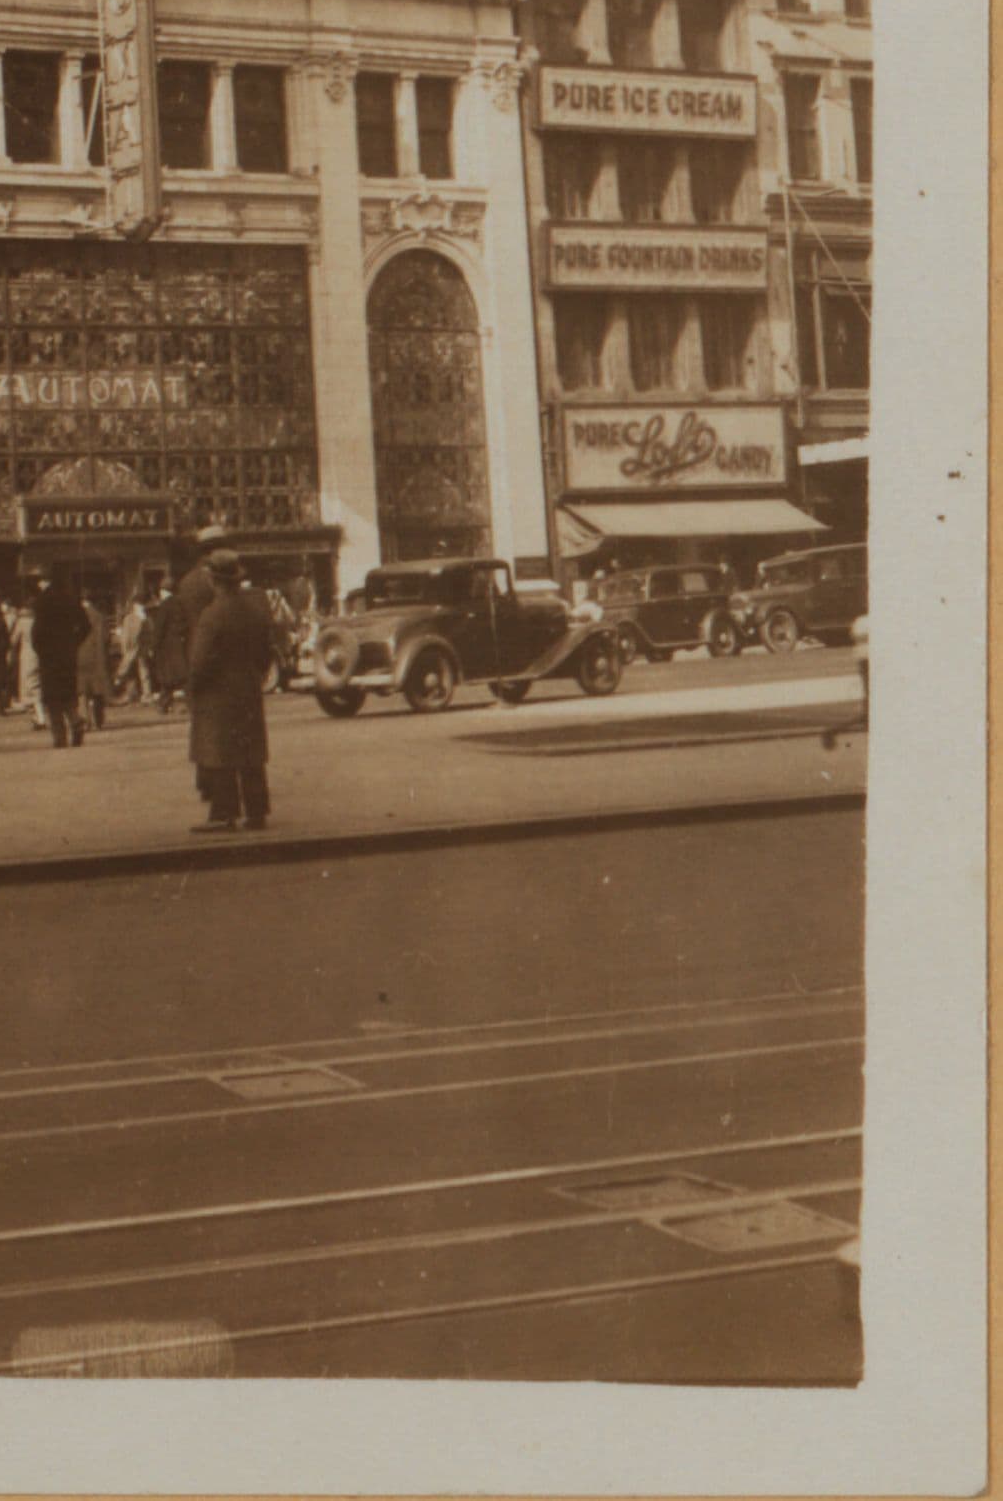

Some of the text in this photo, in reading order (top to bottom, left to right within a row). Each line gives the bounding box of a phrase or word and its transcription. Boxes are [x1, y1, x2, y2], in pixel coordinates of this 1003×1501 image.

[552, 81, 743, 121] PURE ICE CREAM
[554, 243, 764, 273] PURE FOUNTAIN DRINKS
[572, 420, 622, 448] PURE
[715, 444, 774, 476] CANDY
[37, 509, 159, 530] AUTOMAT
